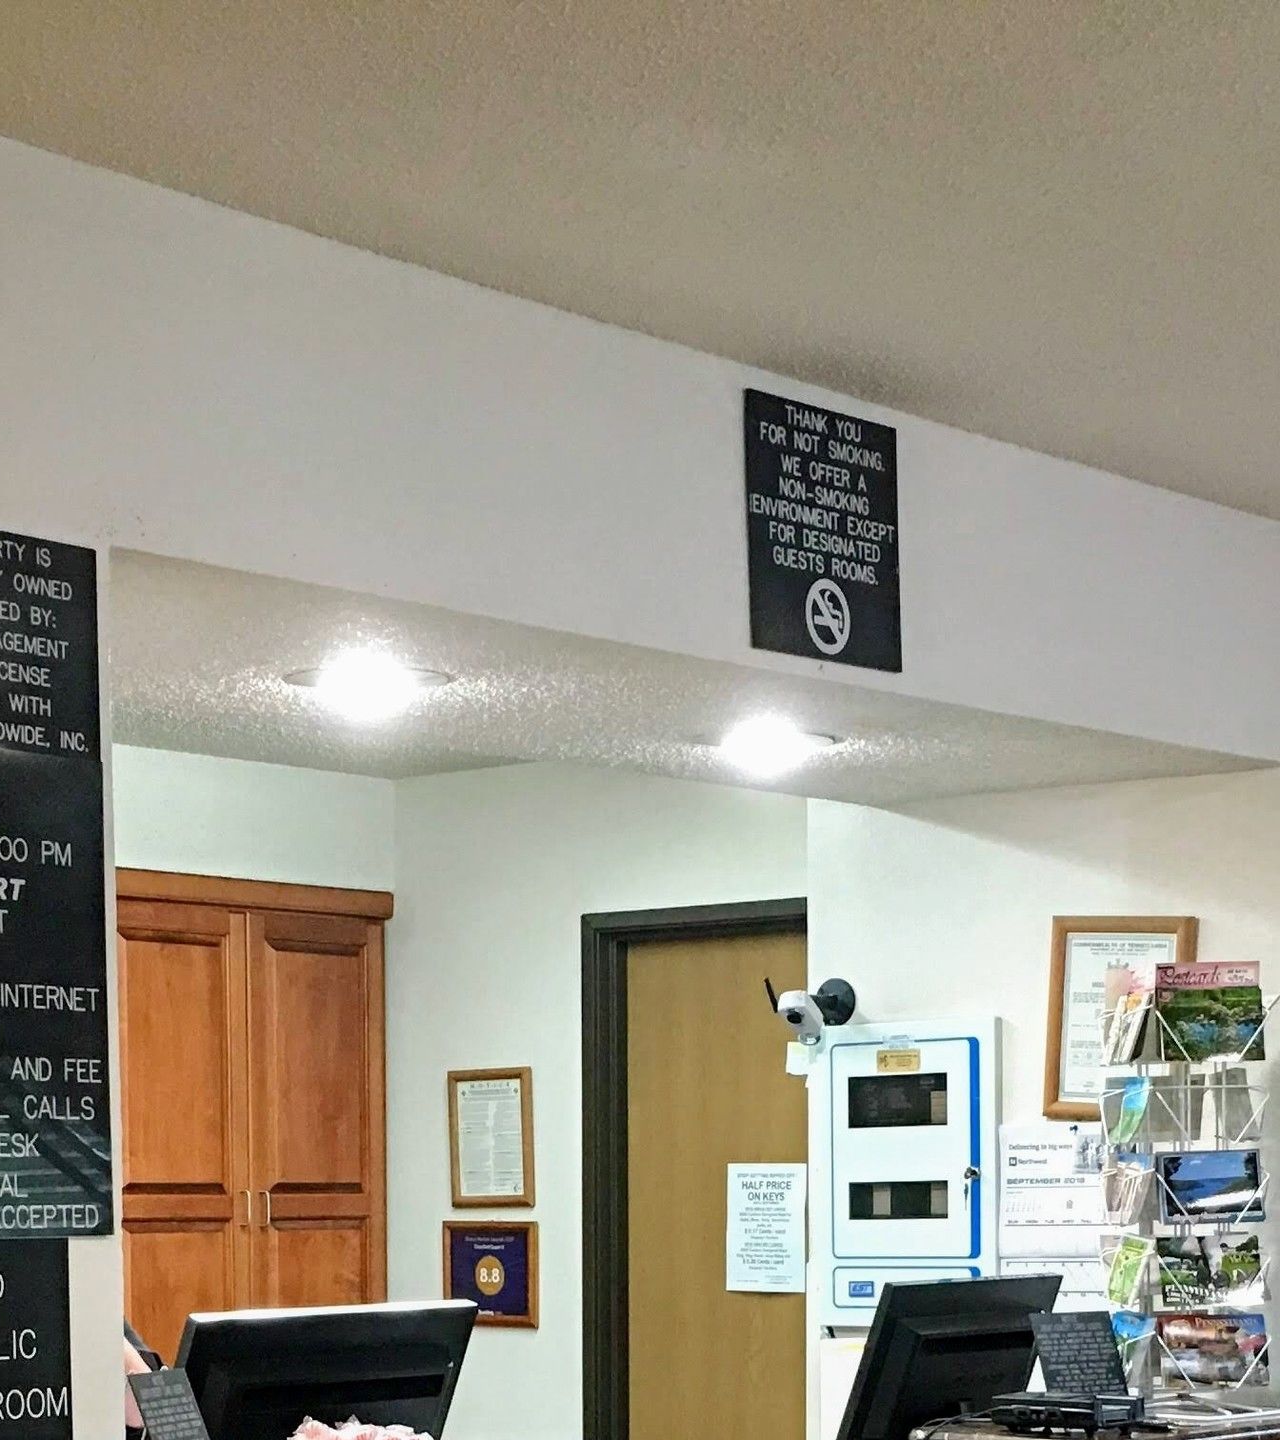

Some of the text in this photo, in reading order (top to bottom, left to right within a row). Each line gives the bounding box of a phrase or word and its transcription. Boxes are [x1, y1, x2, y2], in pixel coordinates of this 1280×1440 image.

[785, 404, 862, 443] THANK YOU
[760, 422, 886, 472] FOR NOT SMOKING.
[781, 454, 866, 491] WE OFFER A
[779, 476, 869, 516] NON-SMOKING
[750, 493, 895, 543] ENVIRONMENT EXCEPT
[769, 521, 880, 563] FOR DESIGNATED
[36, 546, 51, 568] IS
[773, 545, 879, 585] GUESTS ROOMS.
[14, 574, 72, 600] OWNED
[30, 606, 56, 628] BY:
[9, 693, 52, 717] WITH
[60, 731, 89, 752] INC.
[41, 840, 71, 867] PM
[0, 984, 99, 1012] INTERNET
[11, 1056, 52, 1082] AND
[64, 1058, 102, 1084] FEE
[24, 1094, 95, 1120] CALLS
[742, 1181, 792, 1190] HALF PRICE
[748, 1192, 785, 1201] ON KEYS
[480, 1268, 500, 1283] 8.8
